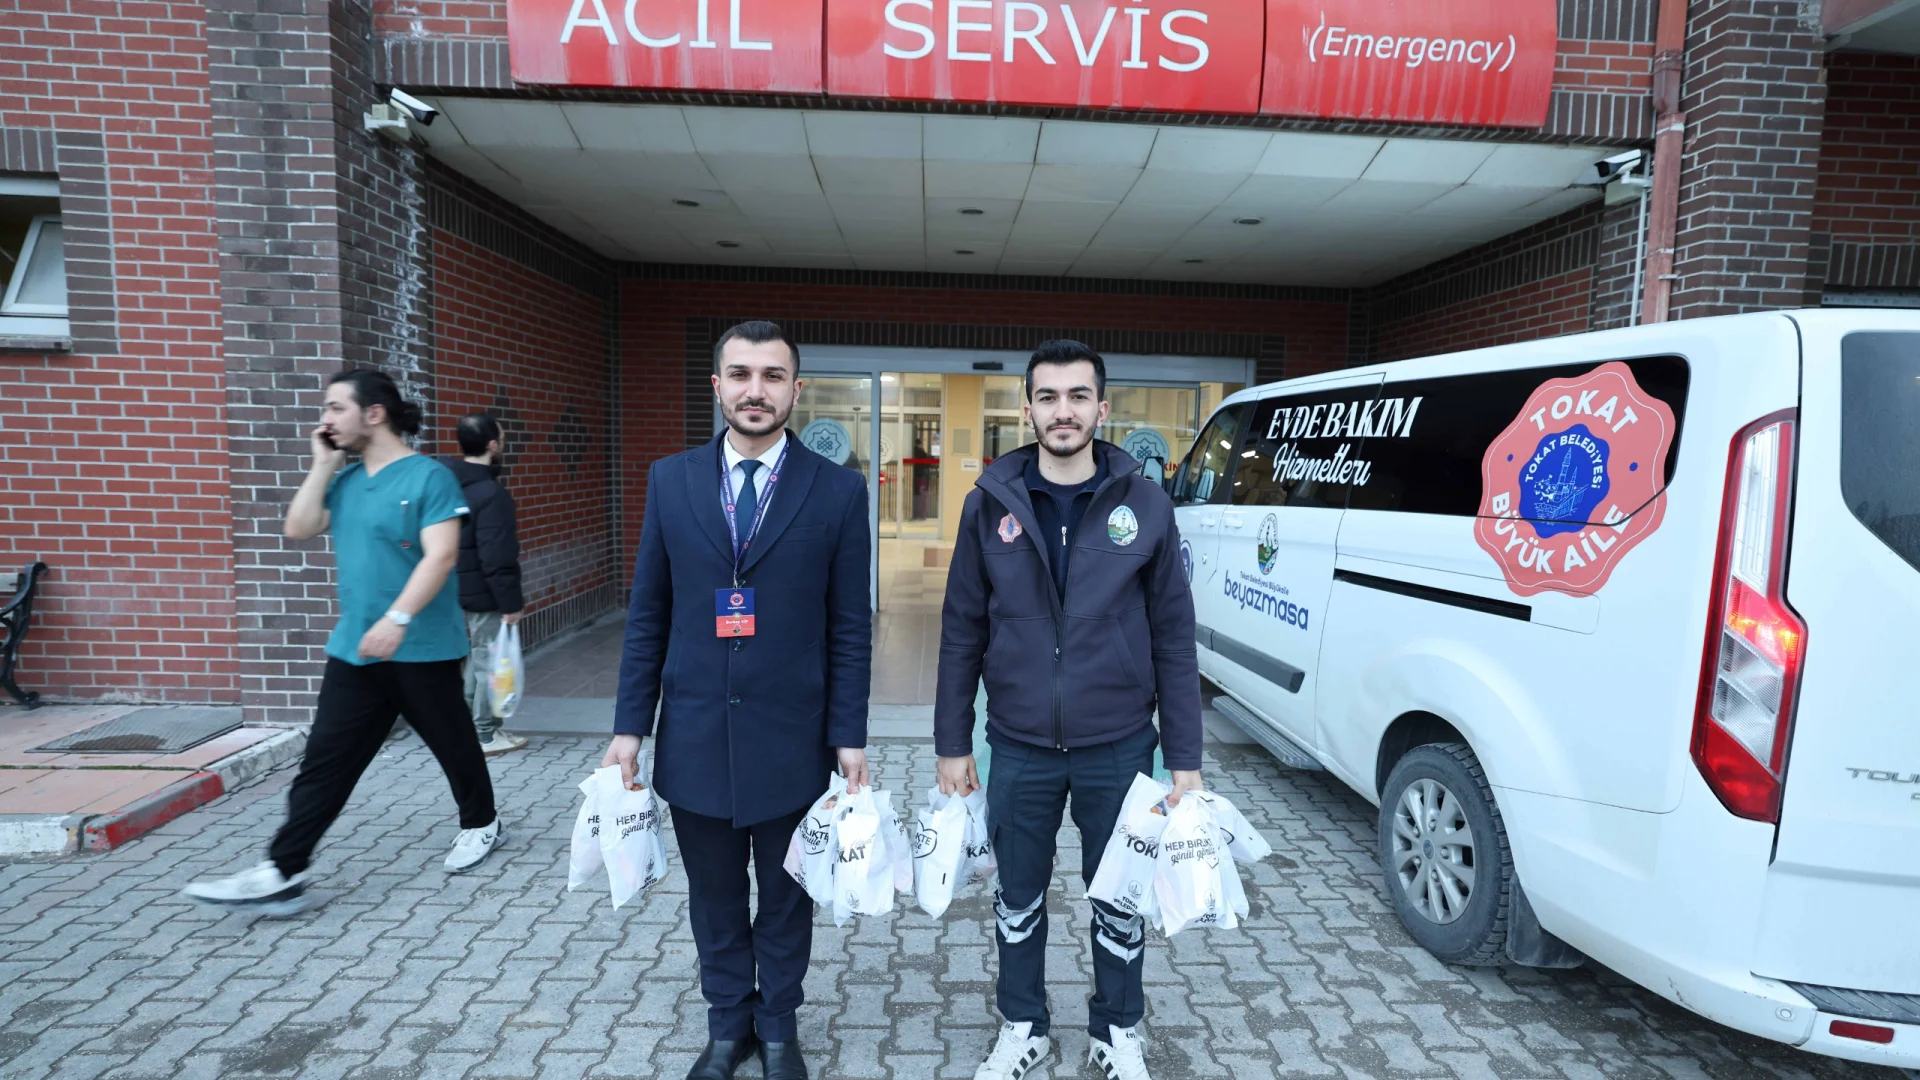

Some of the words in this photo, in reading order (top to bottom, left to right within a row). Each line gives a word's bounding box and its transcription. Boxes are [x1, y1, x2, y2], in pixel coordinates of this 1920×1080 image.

[883, 0, 1210, 73] SERVİS
[1308, 23, 1517, 72] (Emergency)
[1321, 396, 1424, 438] BAKIM
[1529, 390, 1638, 433] TOKAT
[1525, 439, 1557, 482] TOKAT
[1492, 491, 1556, 574] BÜYÜK
[1563, 504, 1634, 573] AİLE
[1224, 569, 1309, 631] beyazmasa
